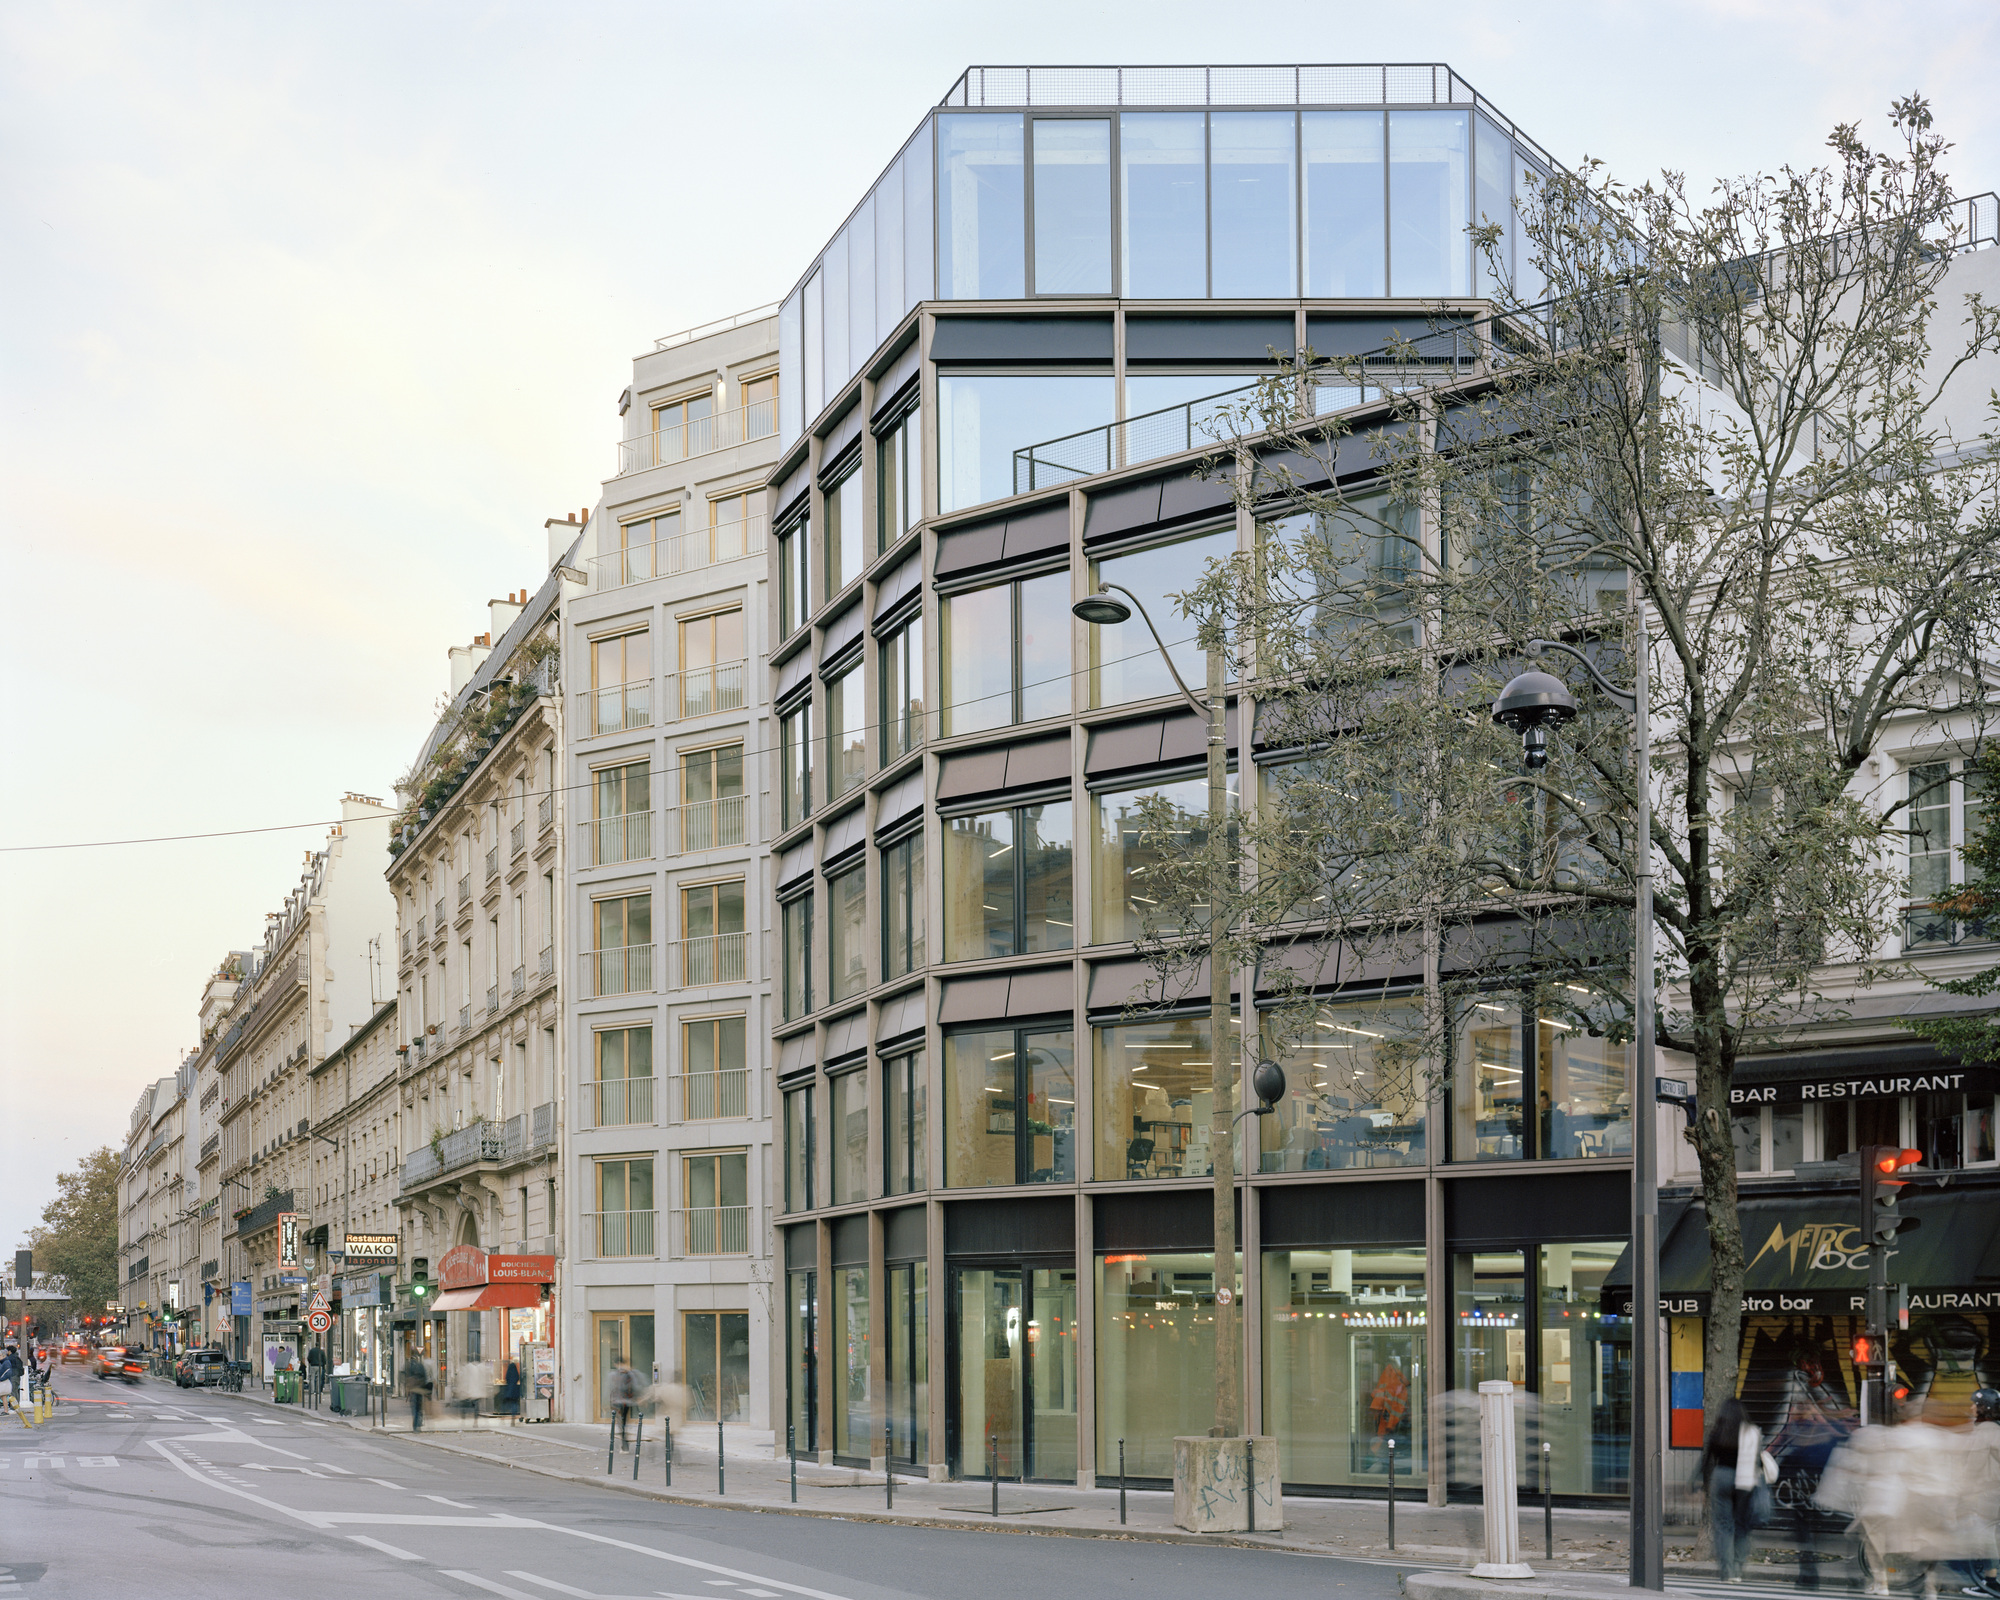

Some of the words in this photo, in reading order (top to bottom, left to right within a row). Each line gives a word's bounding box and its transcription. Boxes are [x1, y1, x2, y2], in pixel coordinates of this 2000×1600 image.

[1661, 1082, 1677, 1094] METRO
[1730, 1087, 1777, 1103] BAR
[1801, 1074, 1965, 1099] RESTAURANT
[346, 1234, 396, 1243] Restaurant
[349, 1244, 394, 1255] WAKO
[348, 1256, 396, 1265] Japonais
[493, 1269, 550, 1277] LOUIS-BLANC
[1740, 1297, 1774, 1312] etro
[1780, 1294, 1814, 1311] bar
[1850, 1292, 2000, 1310] RAURANT
[313, 1317, 327, 1327] 30
